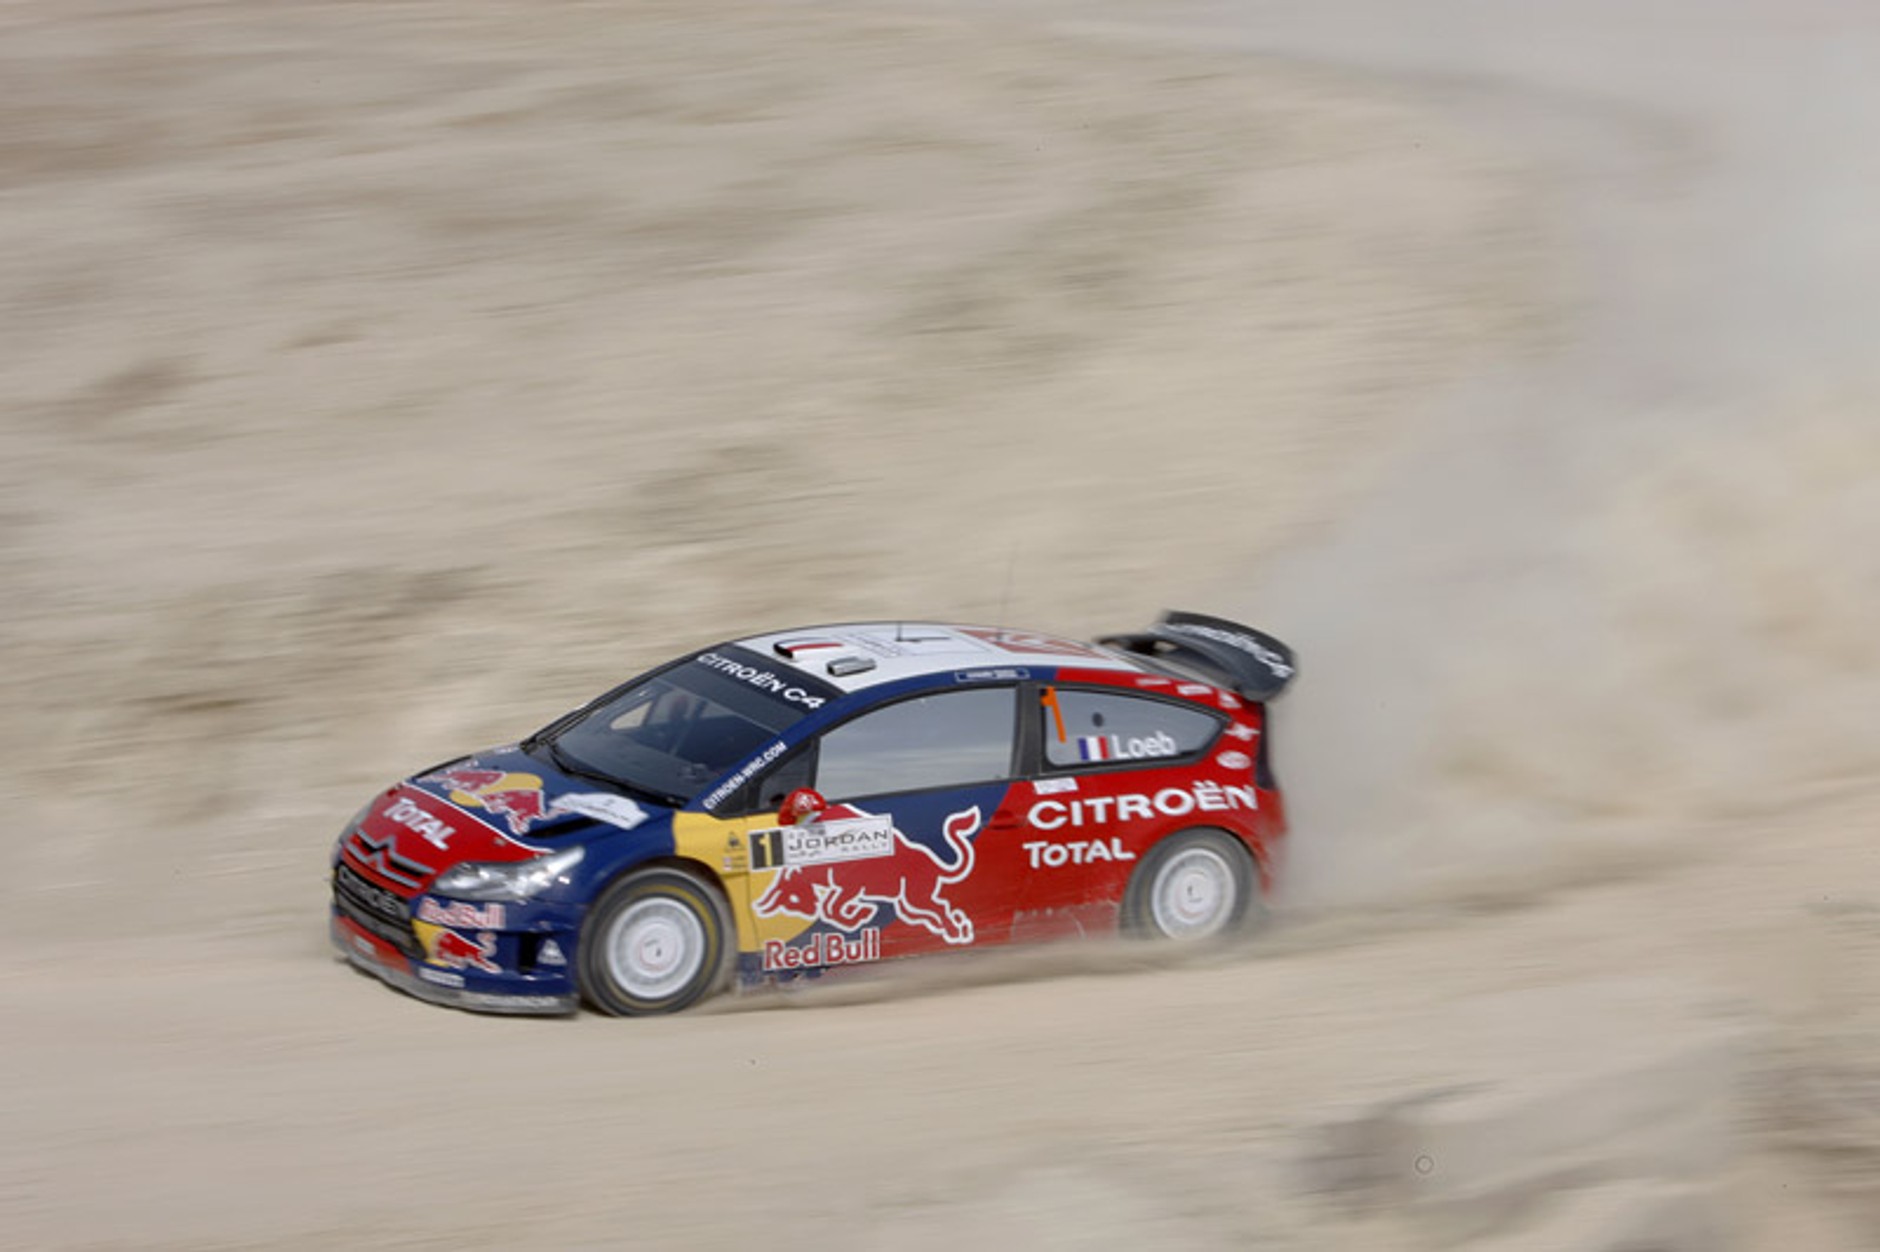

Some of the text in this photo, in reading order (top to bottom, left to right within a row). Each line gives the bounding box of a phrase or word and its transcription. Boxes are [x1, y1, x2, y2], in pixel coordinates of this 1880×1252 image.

[697, 652, 826, 710] CITROËN C4
[1111, 731, 1177, 759] Loeb
[383, 797, 456, 851] TOTAL
[1027, 780, 1258, 830] CITROËN
[758, 832, 773, 867] 1
[789, 829, 889, 851] JORDAN
[1023, 838, 1136, 869] TOTAL
[763, 928, 881, 971] Red Bull
